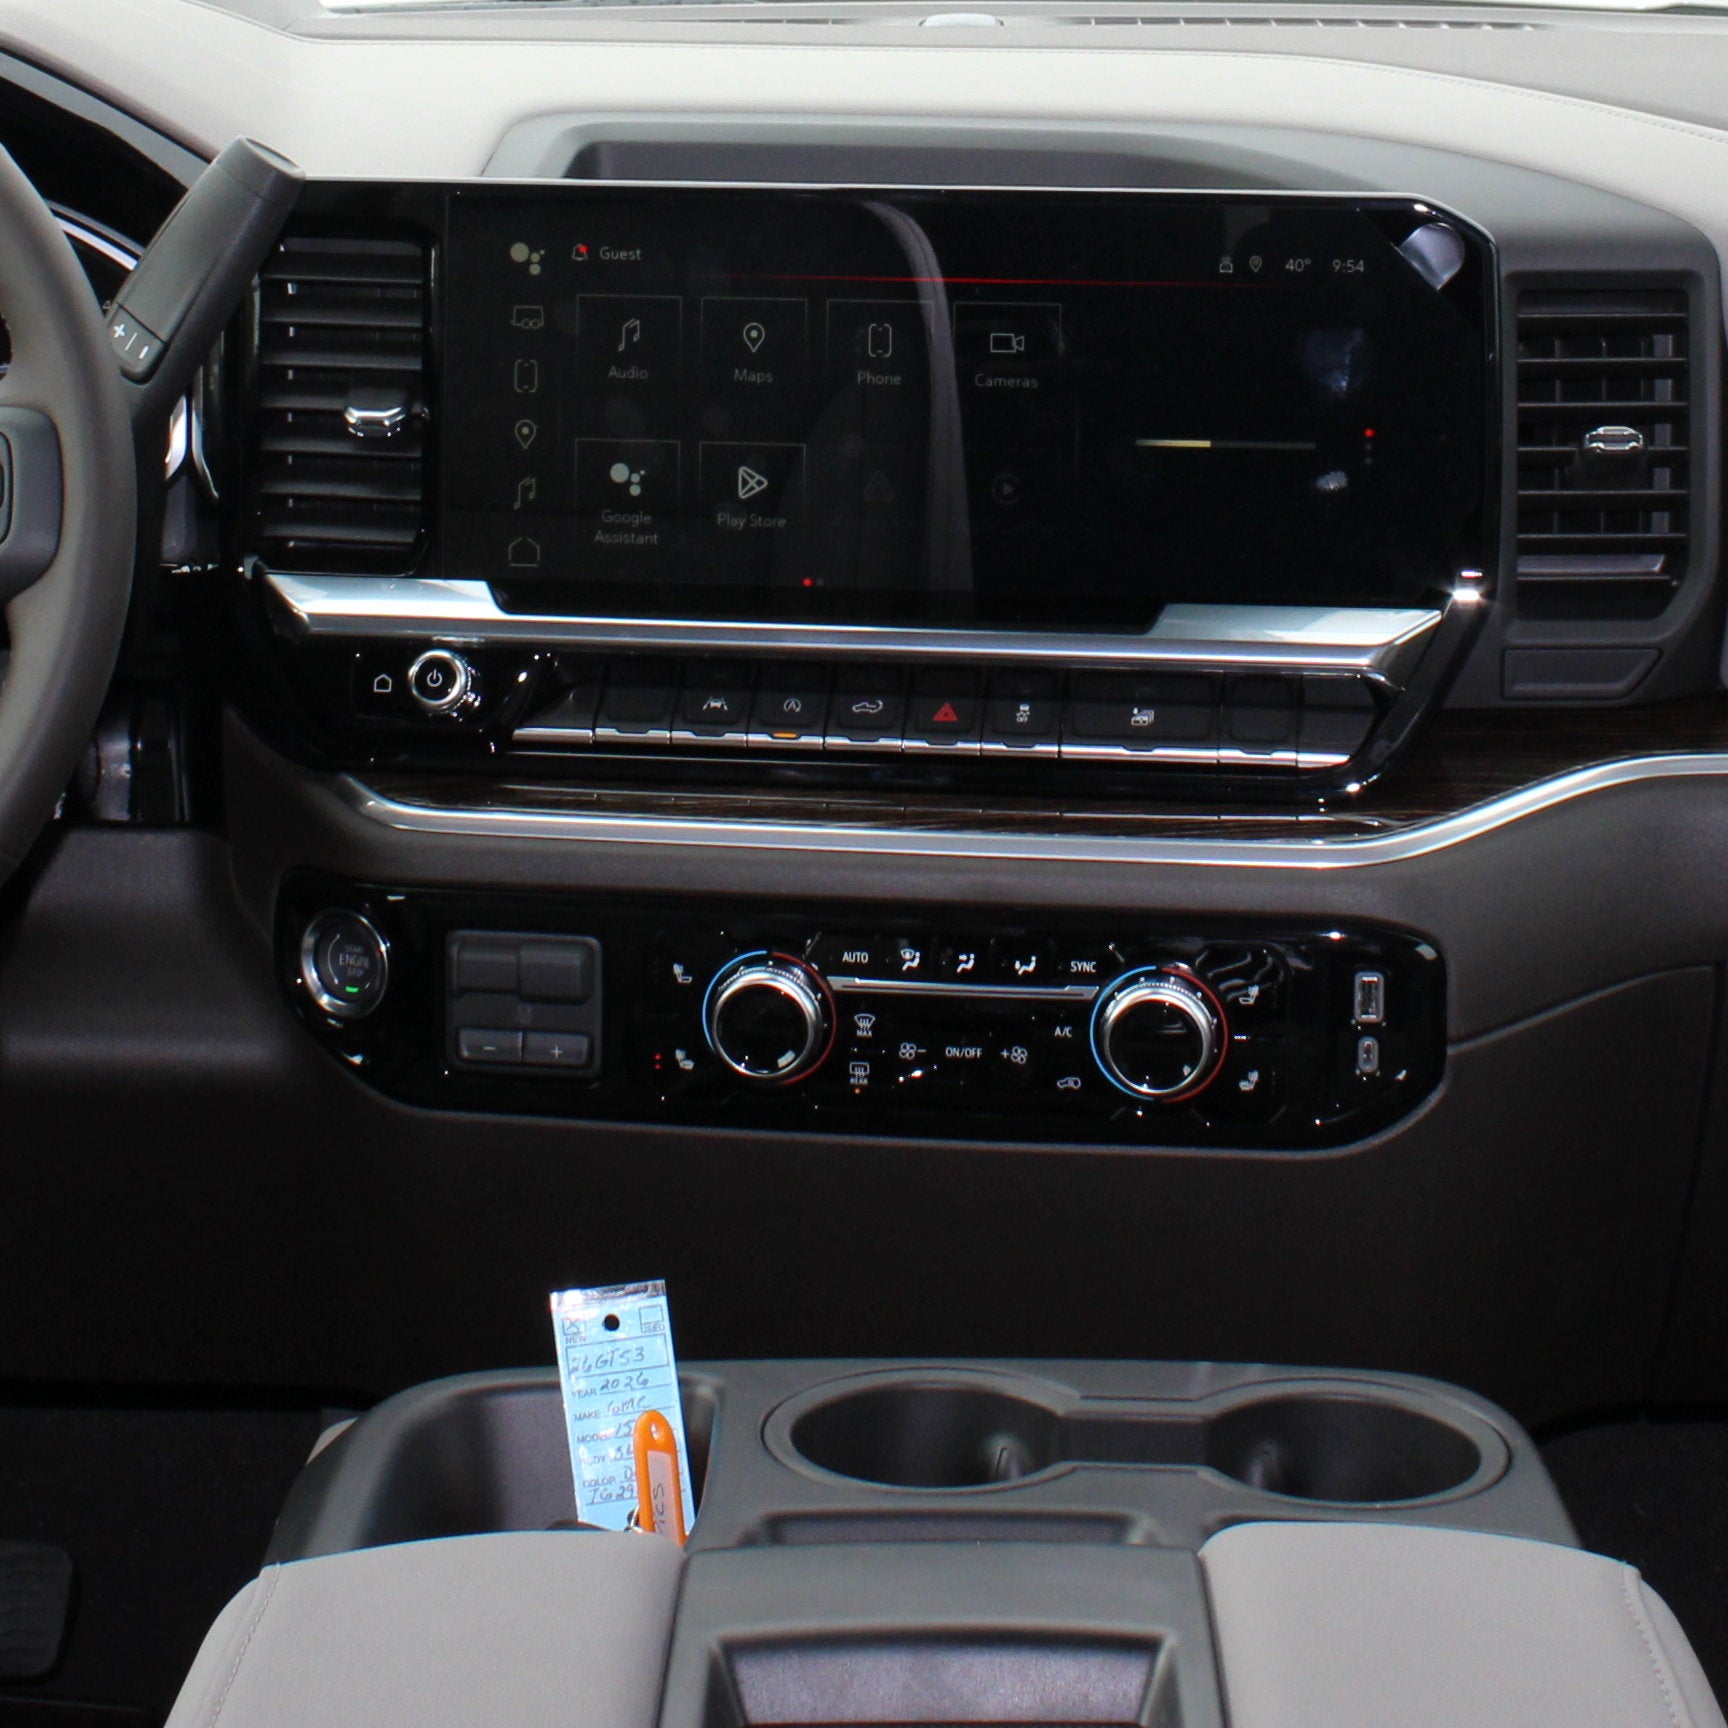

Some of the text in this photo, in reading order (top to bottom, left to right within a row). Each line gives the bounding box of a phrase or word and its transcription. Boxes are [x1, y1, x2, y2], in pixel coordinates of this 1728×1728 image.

[599, 247, 642, 263] Guest
[1332, 259, 1365, 272] 9:54
[608, 366, 648, 380] Audio
[734, 369, 772, 384] Maps
[858, 370, 902, 386] Phone
[975, 374, 1038, 388] Cameras
[601, 510, 652, 527] Google
[718, 514, 786, 530] Play Store
[594, 530, 658, 545] Assistant
[842, 952, 869, 964] AUTO
[1070, 961, 1096, 972] SYNC
[856, 1028, 872, 1037] MAX
[1054, 1026, 1072, 1038] A/C
[946, 1047, 982, 1058] ON/OFF
[565, 1335, 586, 1344] NEW
[600, 1371, 650, 1390] 2026
[572, 1388, 597, 1398] YEAR
[574, 1412, 600, 1422] MAKE
[582, 1476, 616, 1488] COLOR
